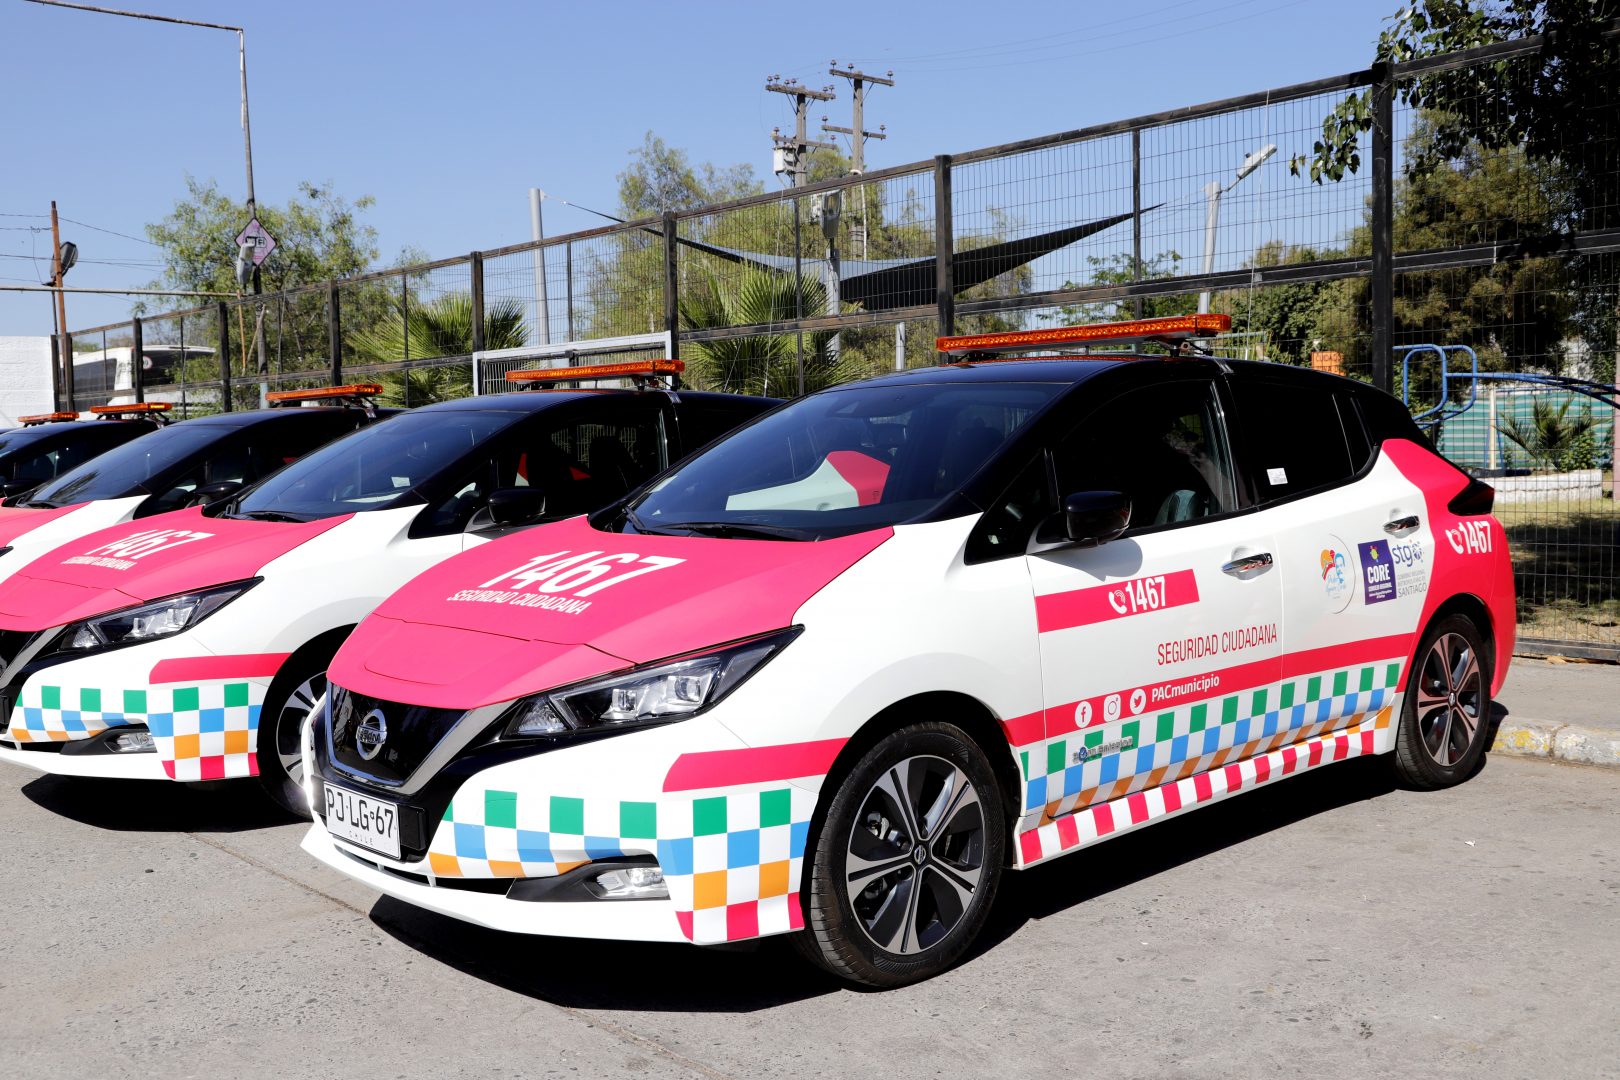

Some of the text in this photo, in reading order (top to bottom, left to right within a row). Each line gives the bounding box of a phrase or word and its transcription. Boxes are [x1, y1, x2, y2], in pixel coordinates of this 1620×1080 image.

[84, 529, 216, 559] 1467
[1458, 520, 1492, 554] 1467
[478, 550, 687, 597] 1467
[1367, 564, 1390, 584] CORE
[447, 590, 592, 615] SEGURIDAD CIUDADANA
[1125, 576, 1166, 612] 1467
[1397, 583, 1427, 598] SANTIAGO
[1158, 623, 1277, 665] SEGURIDAD CIUDADANA
[1151, 674, 1220, 703] PACmunicipio
